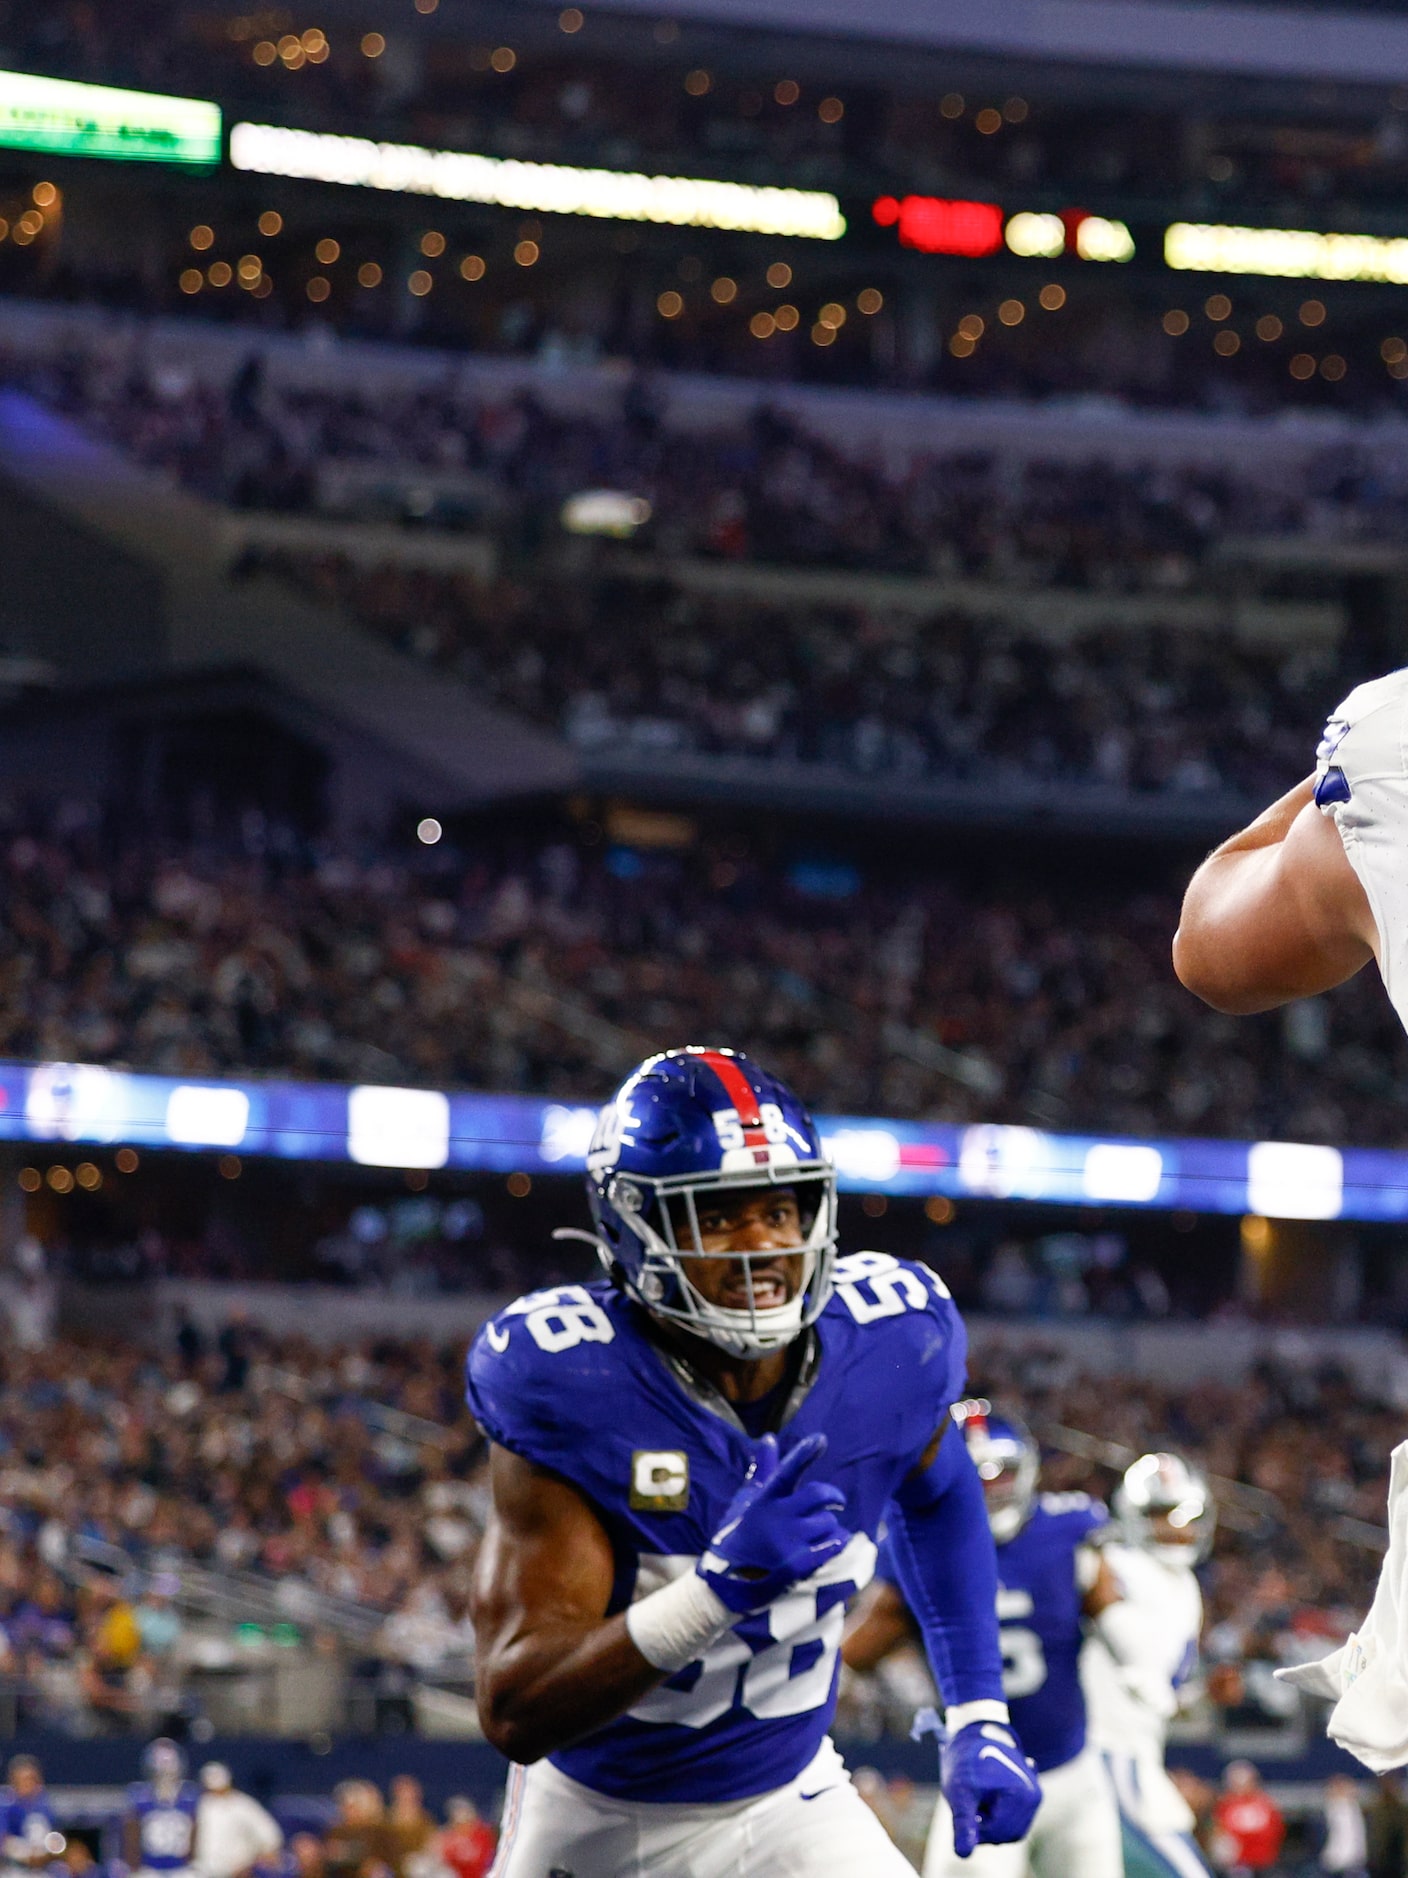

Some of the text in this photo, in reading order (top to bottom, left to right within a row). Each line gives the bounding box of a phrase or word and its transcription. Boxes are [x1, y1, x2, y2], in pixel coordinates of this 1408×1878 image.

[505, 1284, 616, 1353] 58
[827, 1250, 929, 1325] 58
[634, 1453, 687, 1497] C
